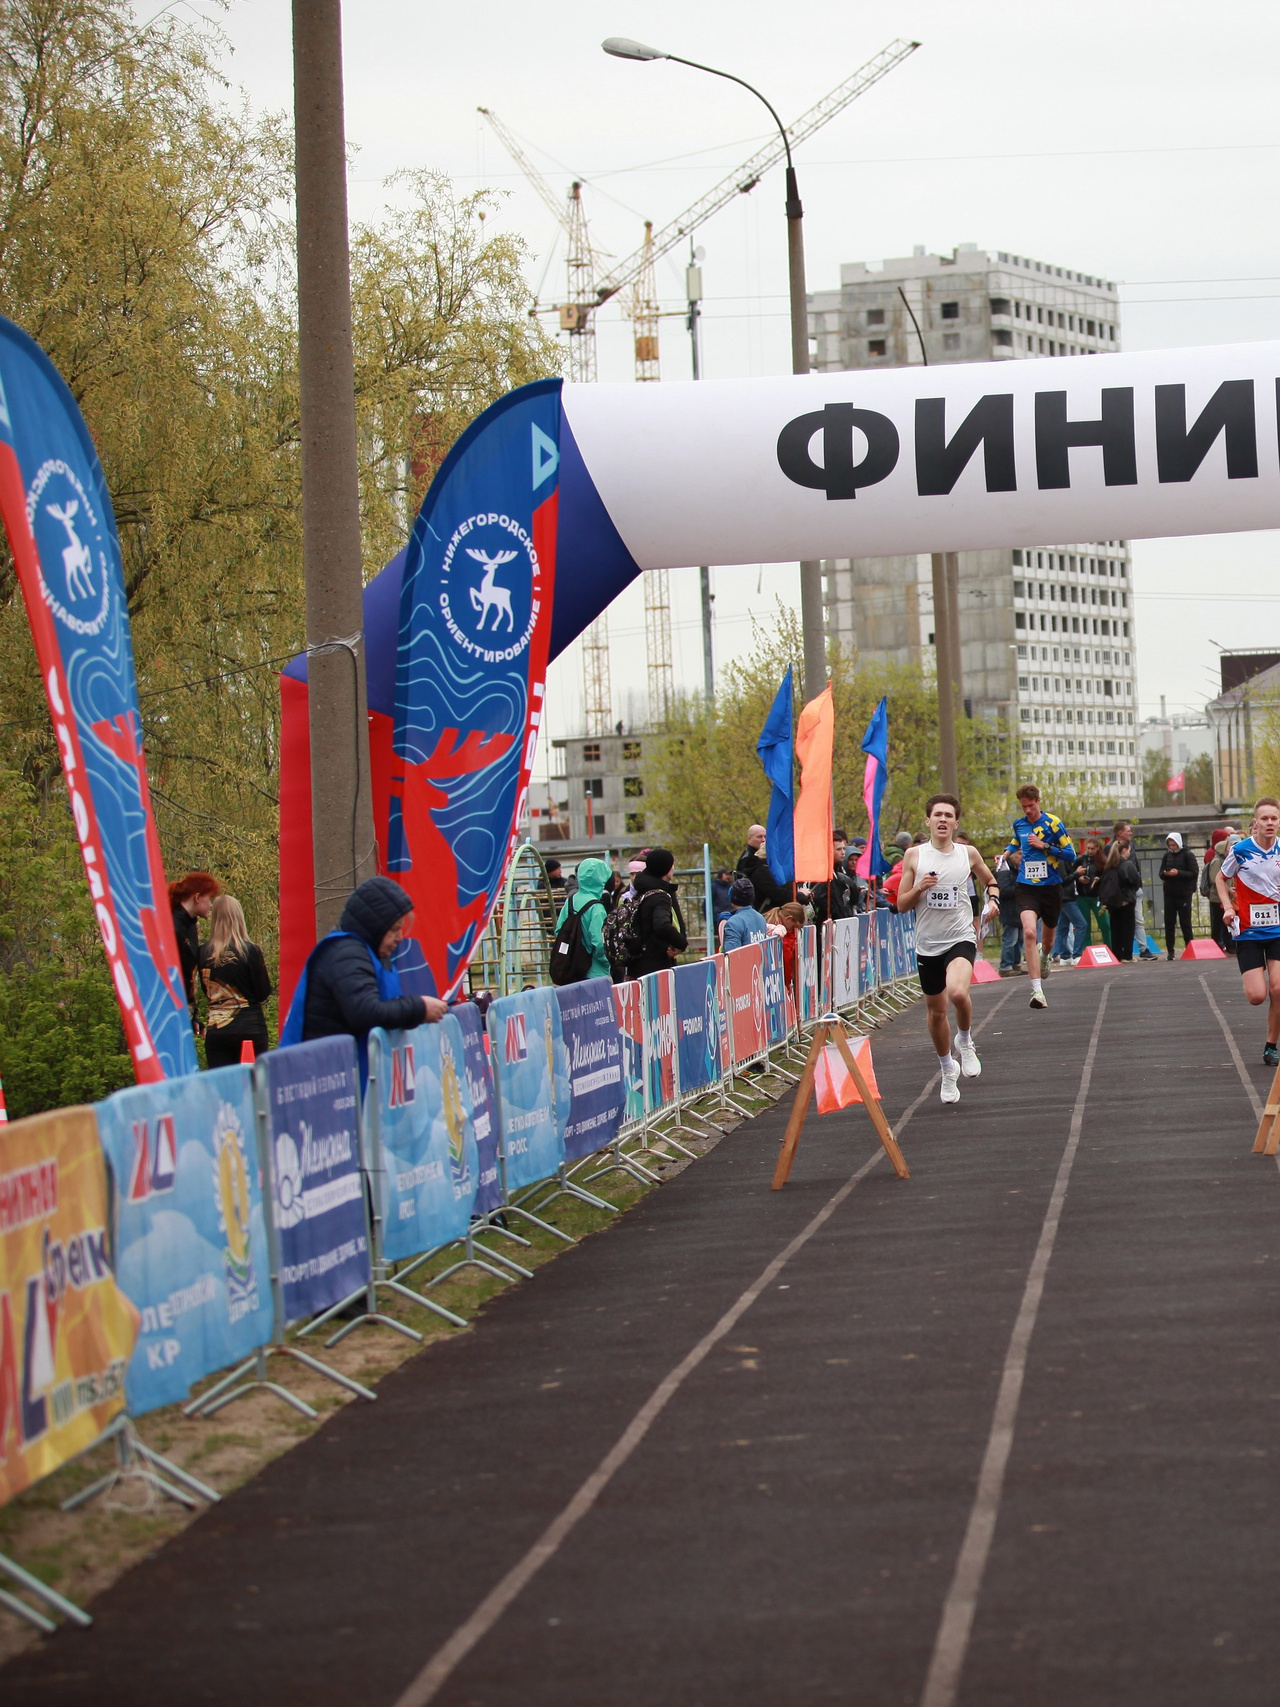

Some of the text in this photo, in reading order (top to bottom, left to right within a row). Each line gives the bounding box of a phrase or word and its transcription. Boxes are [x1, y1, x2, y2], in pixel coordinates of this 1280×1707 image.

[442, 513, 541, 577] НИЖЕГОРОДСКОЕ
[440, 593, 541, 663] ОРИЕНТИРОВАНИЕ
[931, 892, 949, 901] 362
